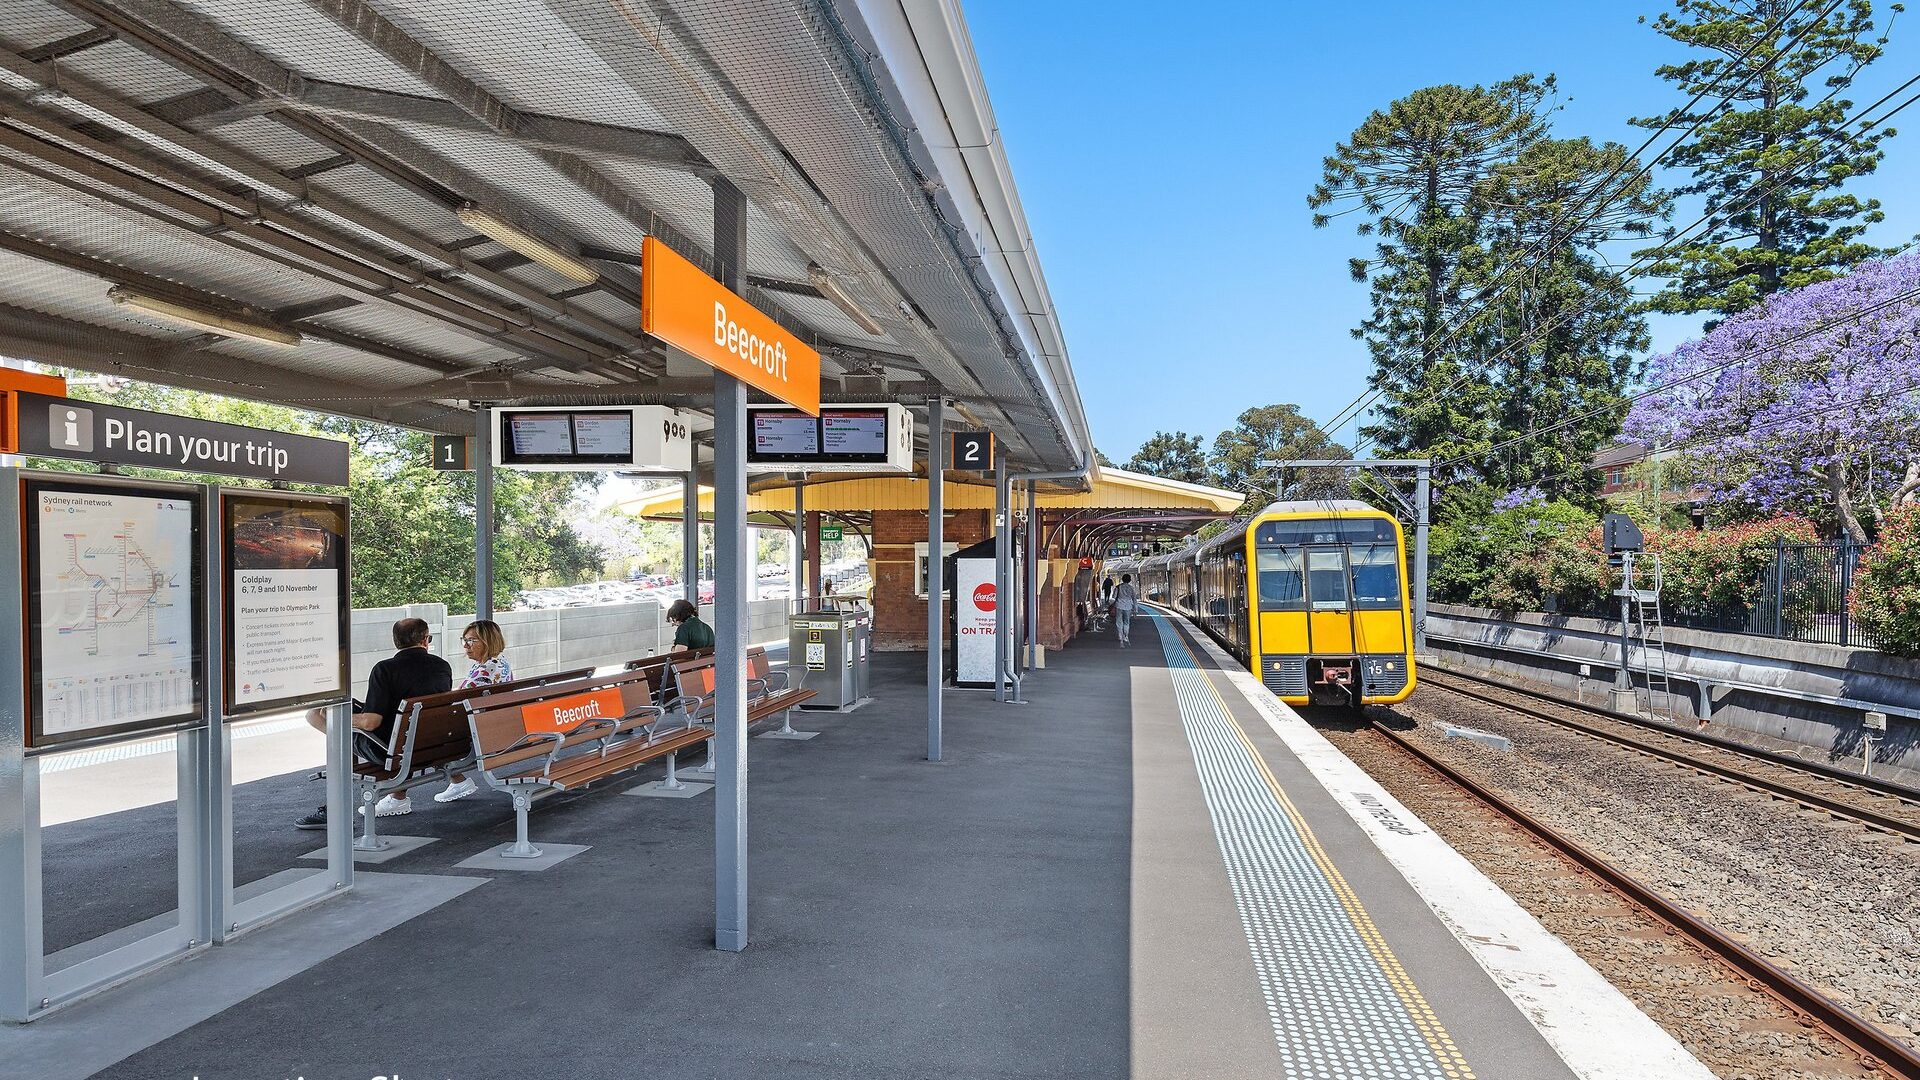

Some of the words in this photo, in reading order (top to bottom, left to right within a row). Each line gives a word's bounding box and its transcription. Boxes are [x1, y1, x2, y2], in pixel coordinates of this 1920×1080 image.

[714, 300, 788, 383] Beecroft
[105, 418, 172, 455] Plan
[180, 435, 240, 464] your
[246, 441, 289, 475] trip
[965, 441, 980, 461] 2
[444, 444, 455, 463] 1
[43, 496, 71, 505] Sydney
[84, 499, 113, 507] network
[241, 576, 273, 584] Coldplay
[241, 586, 249, 594] 6,
[250, 586, 257, 594] 7,
[264, 585, 276, 593] and
[286, 604, 308, 612] Olympic
[961, 627, 977, 635] ON
[1369, 666, 1382, 674] 15
[553, 700, 601, 725] Beecroft
